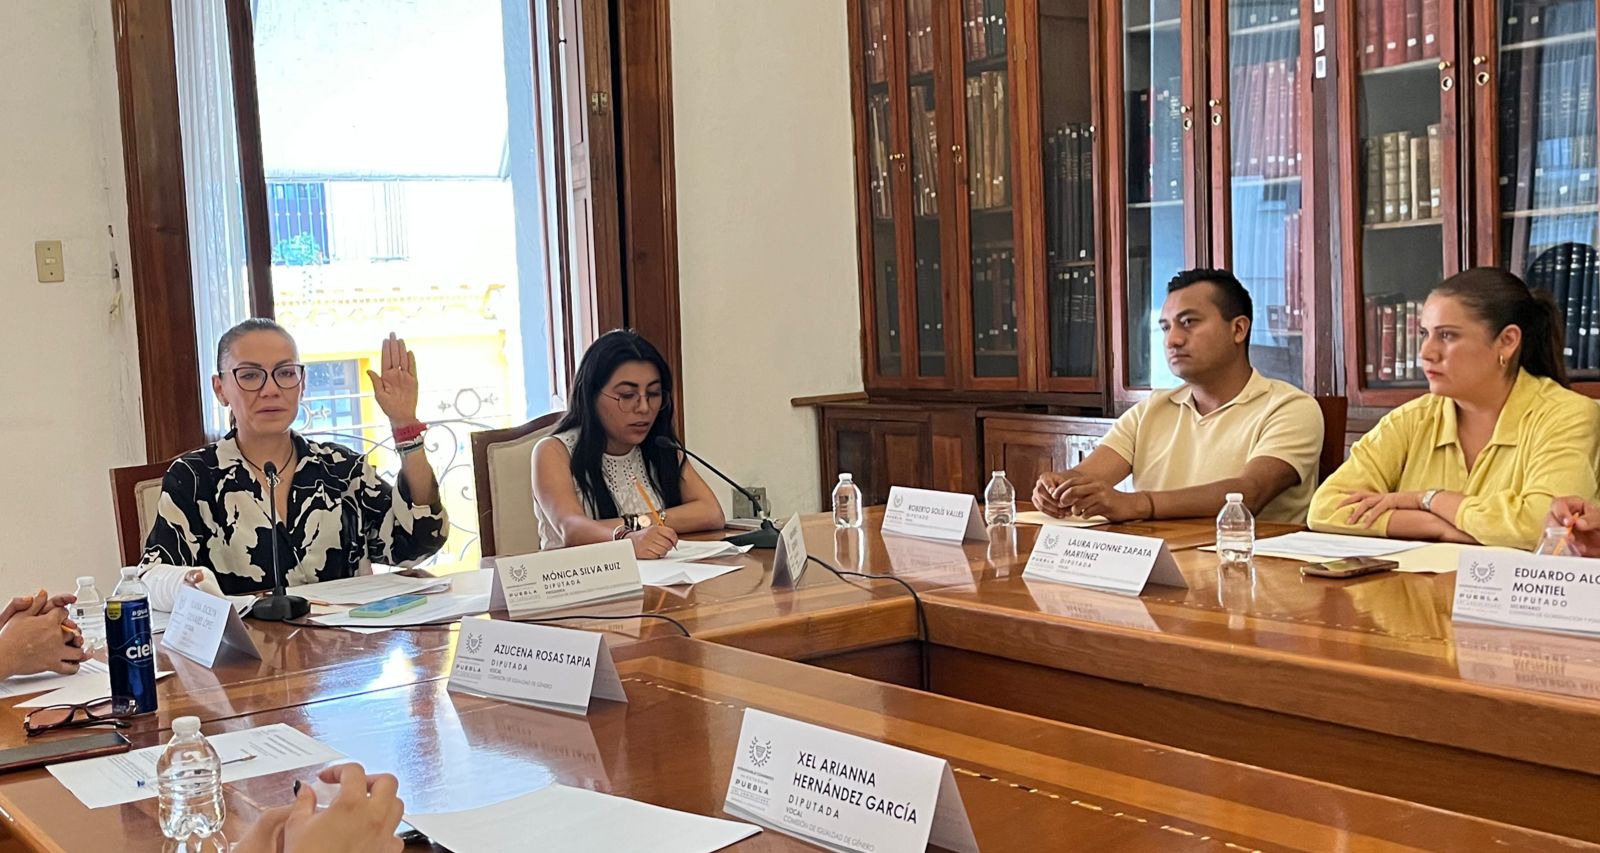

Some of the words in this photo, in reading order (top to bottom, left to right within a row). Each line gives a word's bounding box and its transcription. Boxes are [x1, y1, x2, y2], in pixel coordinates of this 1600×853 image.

[908, 504, 930, 514] ROBERTO
[1063, 549, 1099, 561] MARTÍNEZ
[1068, 538, 1091, 549] LAURA
[1092, 541, 1122, 552] IVONNE
[1122, 546, 1152, 558] ZAPATA
[1059, 558, 1092, 568] DIPUTADA
[542, 569, 578, 582] MÓNICA
[579, 565, 602, 576] SILVA
[604, 562, 621, 571] RUIZ
[1514, 567, 1575, 582] EDUARDO
[544, 579, 581, 590] DIPUTADA
[1512, 582, 1566, 596] MONTIEL
[1459, 593, 1499, 601] PUEBLA
[1511, 595, 1568, 607] DIPUTADO
[493, 643, 533, 658] AZUCENA
[535, 649, 564, 664] ROSAS
[566, 653, 591, 668] TAPIA
[491, 659, 528, 670] DIPUTADA
[797, 750, 816, 769] XEL
[819, 758, 876, 787] ARIANNA
[735, 778, 769, 795] PUEBLA
[792, 772, 863, 806] HERNÁNDEZ
[865, 794, 917, 824] GARCÍA
[786, 806, 803, 817] VOCAL
[788, 794, 840, 819] DIPUTADA
